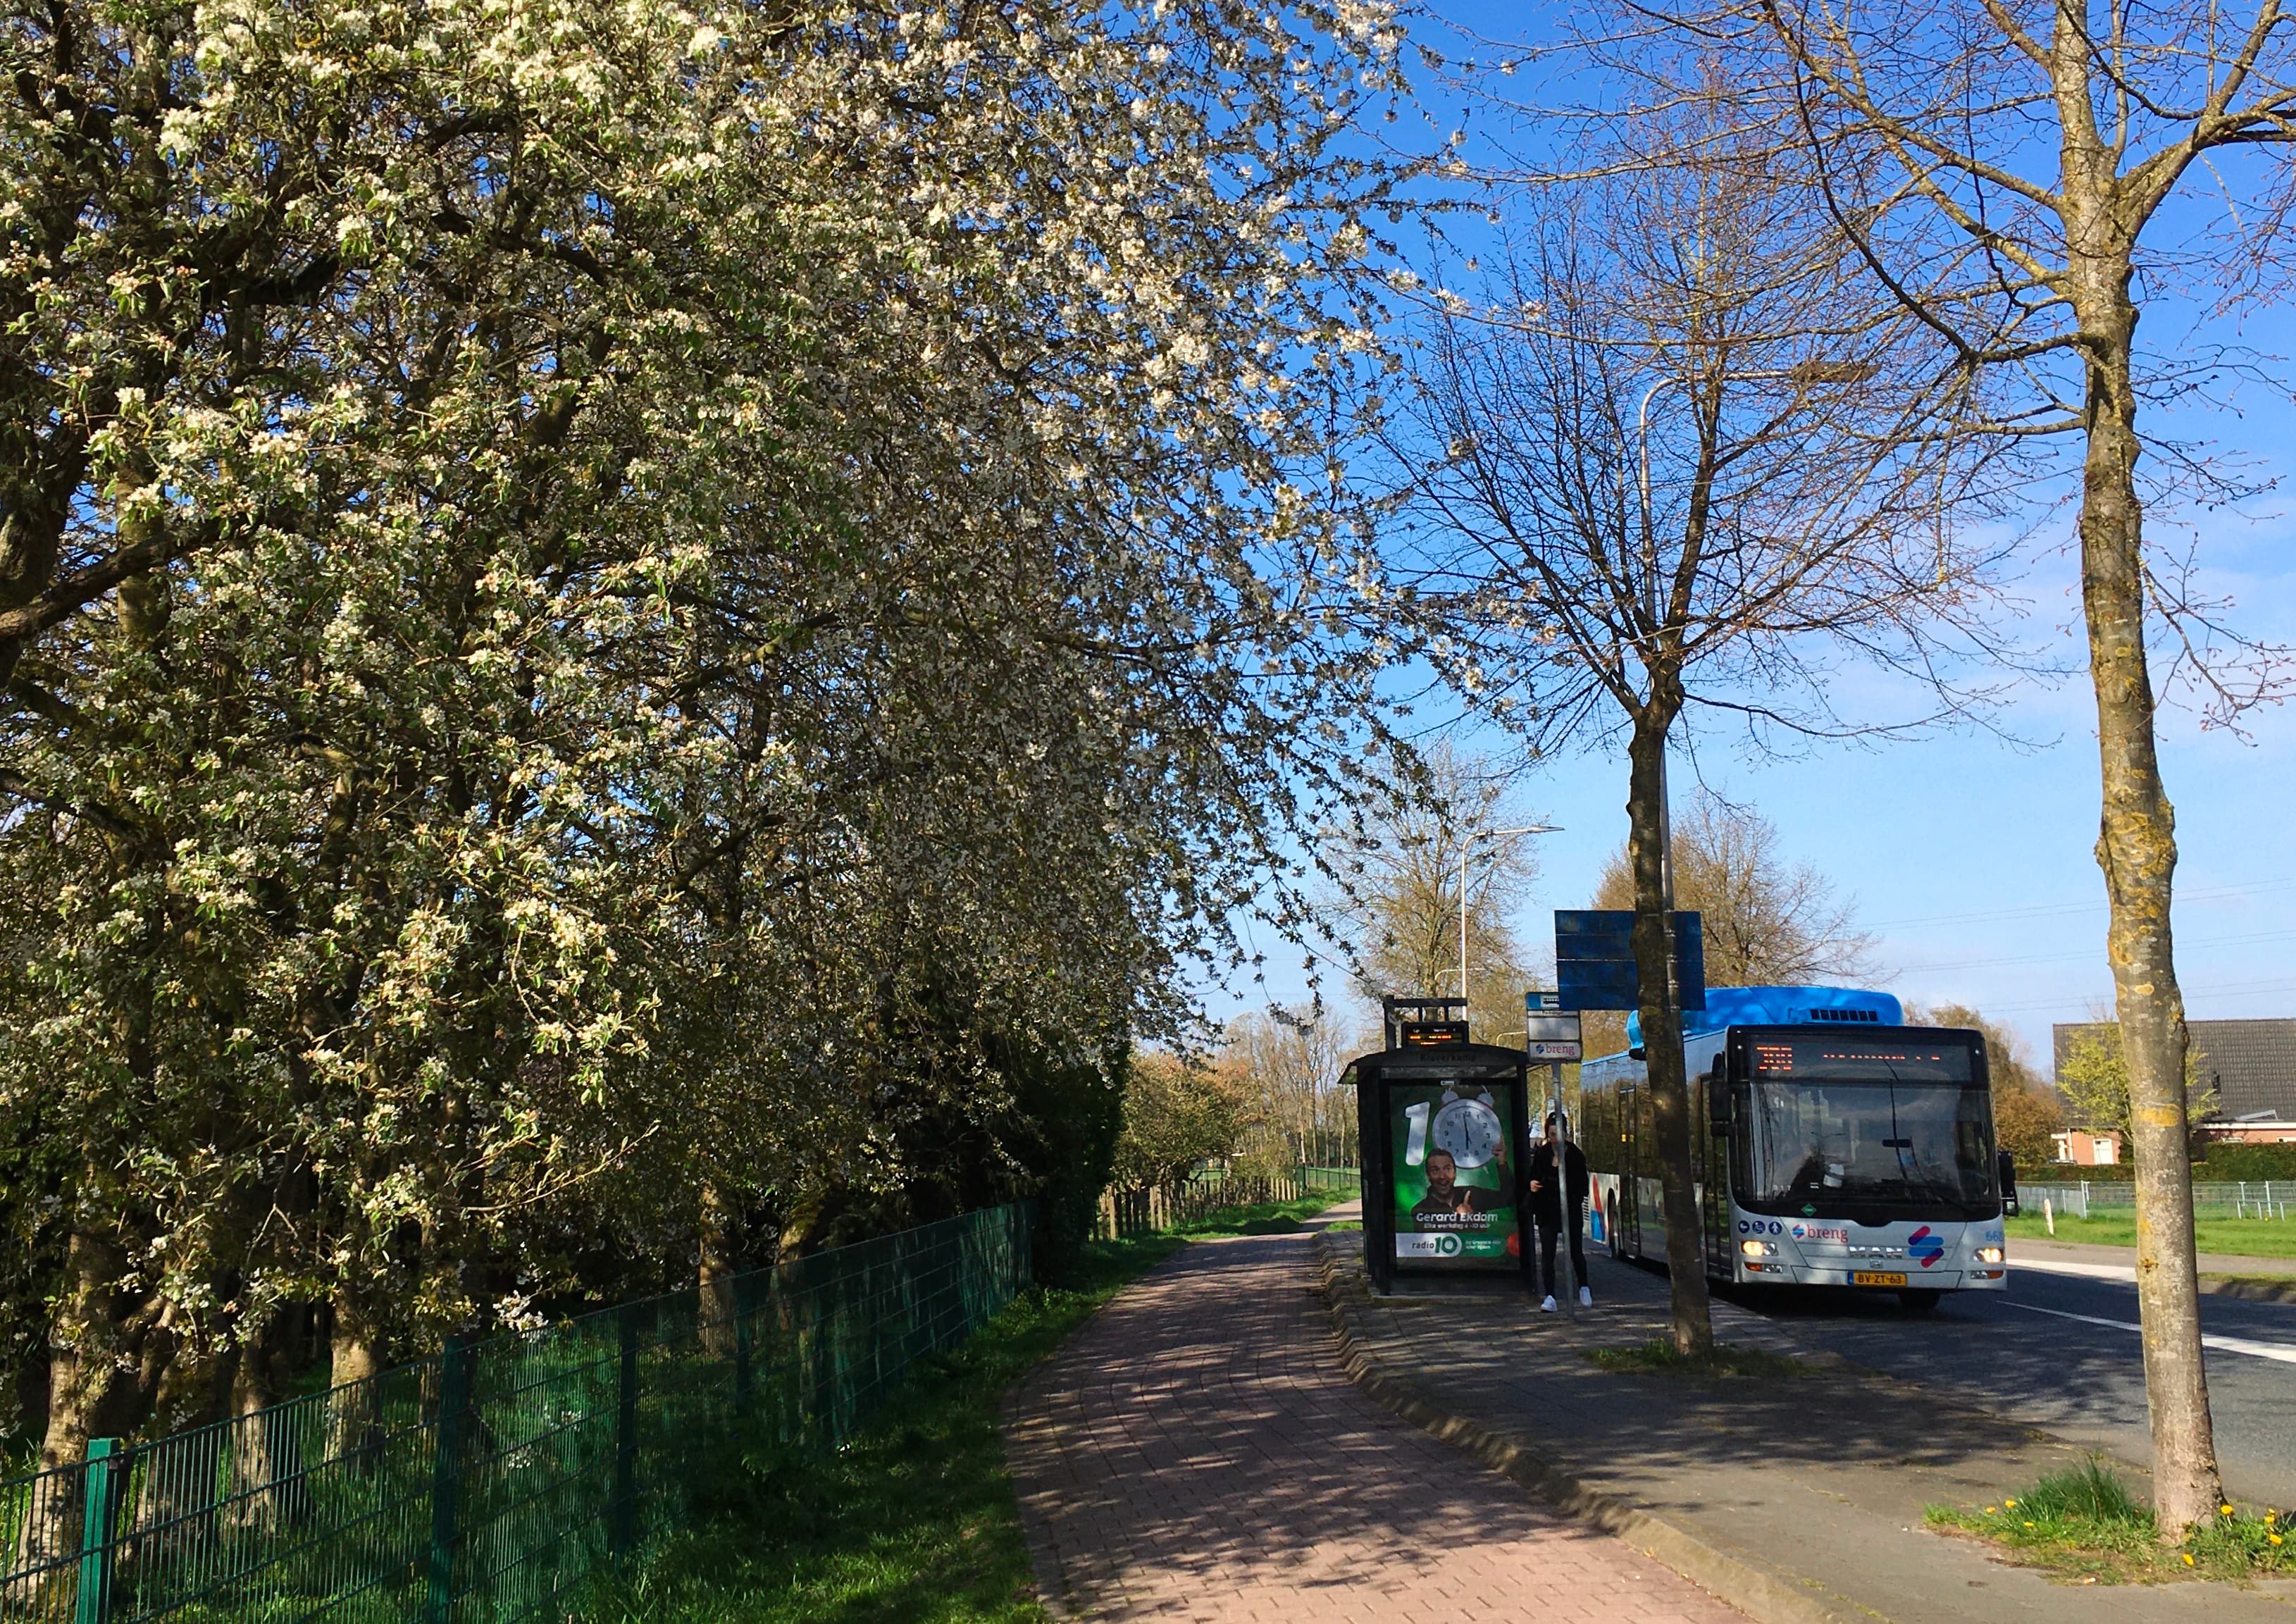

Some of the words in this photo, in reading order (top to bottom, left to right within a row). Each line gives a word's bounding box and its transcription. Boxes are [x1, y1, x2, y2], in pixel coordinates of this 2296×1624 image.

[1546, 1043, 1575, 1056] breng
[1416, 1211, 1457, 1222] Gerard
[1460, 1211, 1498, 1222] Ekdom
[1806, 1225, 1849, 1244] breng
[1434, 1236, 1458, 1253] 10
[1849, 1246, 1902, 1258] MAN
